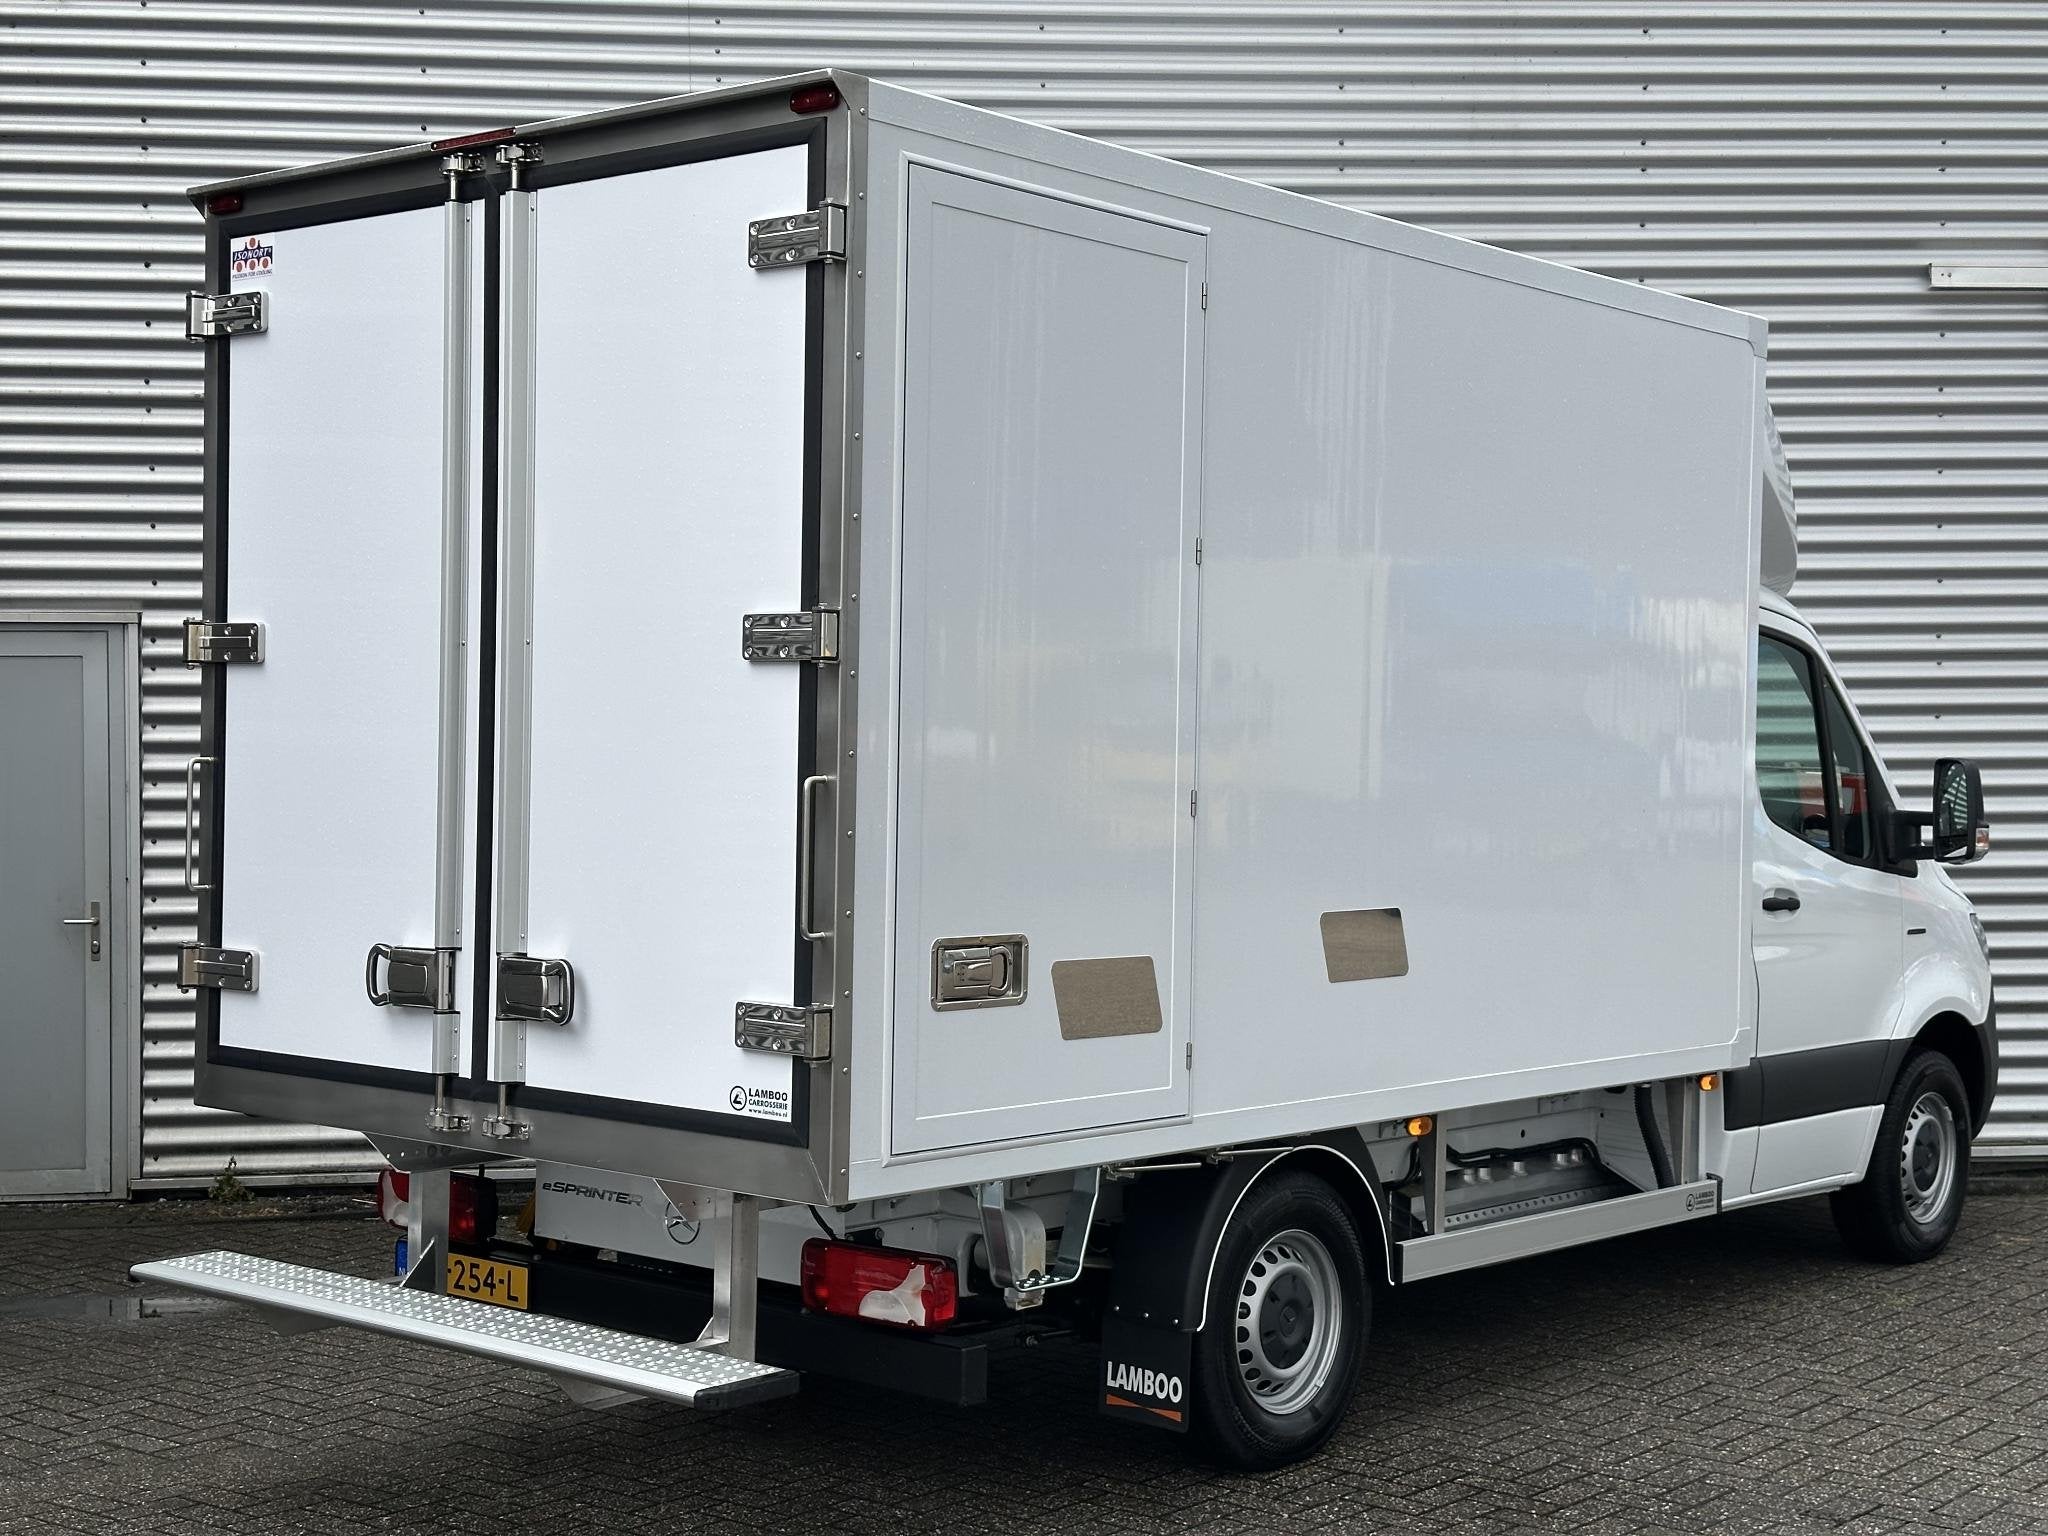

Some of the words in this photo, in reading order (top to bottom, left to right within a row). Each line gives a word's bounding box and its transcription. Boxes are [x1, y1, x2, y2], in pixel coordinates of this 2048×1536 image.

[749, 1088, 788, 1101] LAMBOO
[749, 1098, 788, 1110] CARROSSERIE
[542, 1181, 644, 1207] eSPRINTER
[1106, 1361, 1182, 1403] LAMBOO
